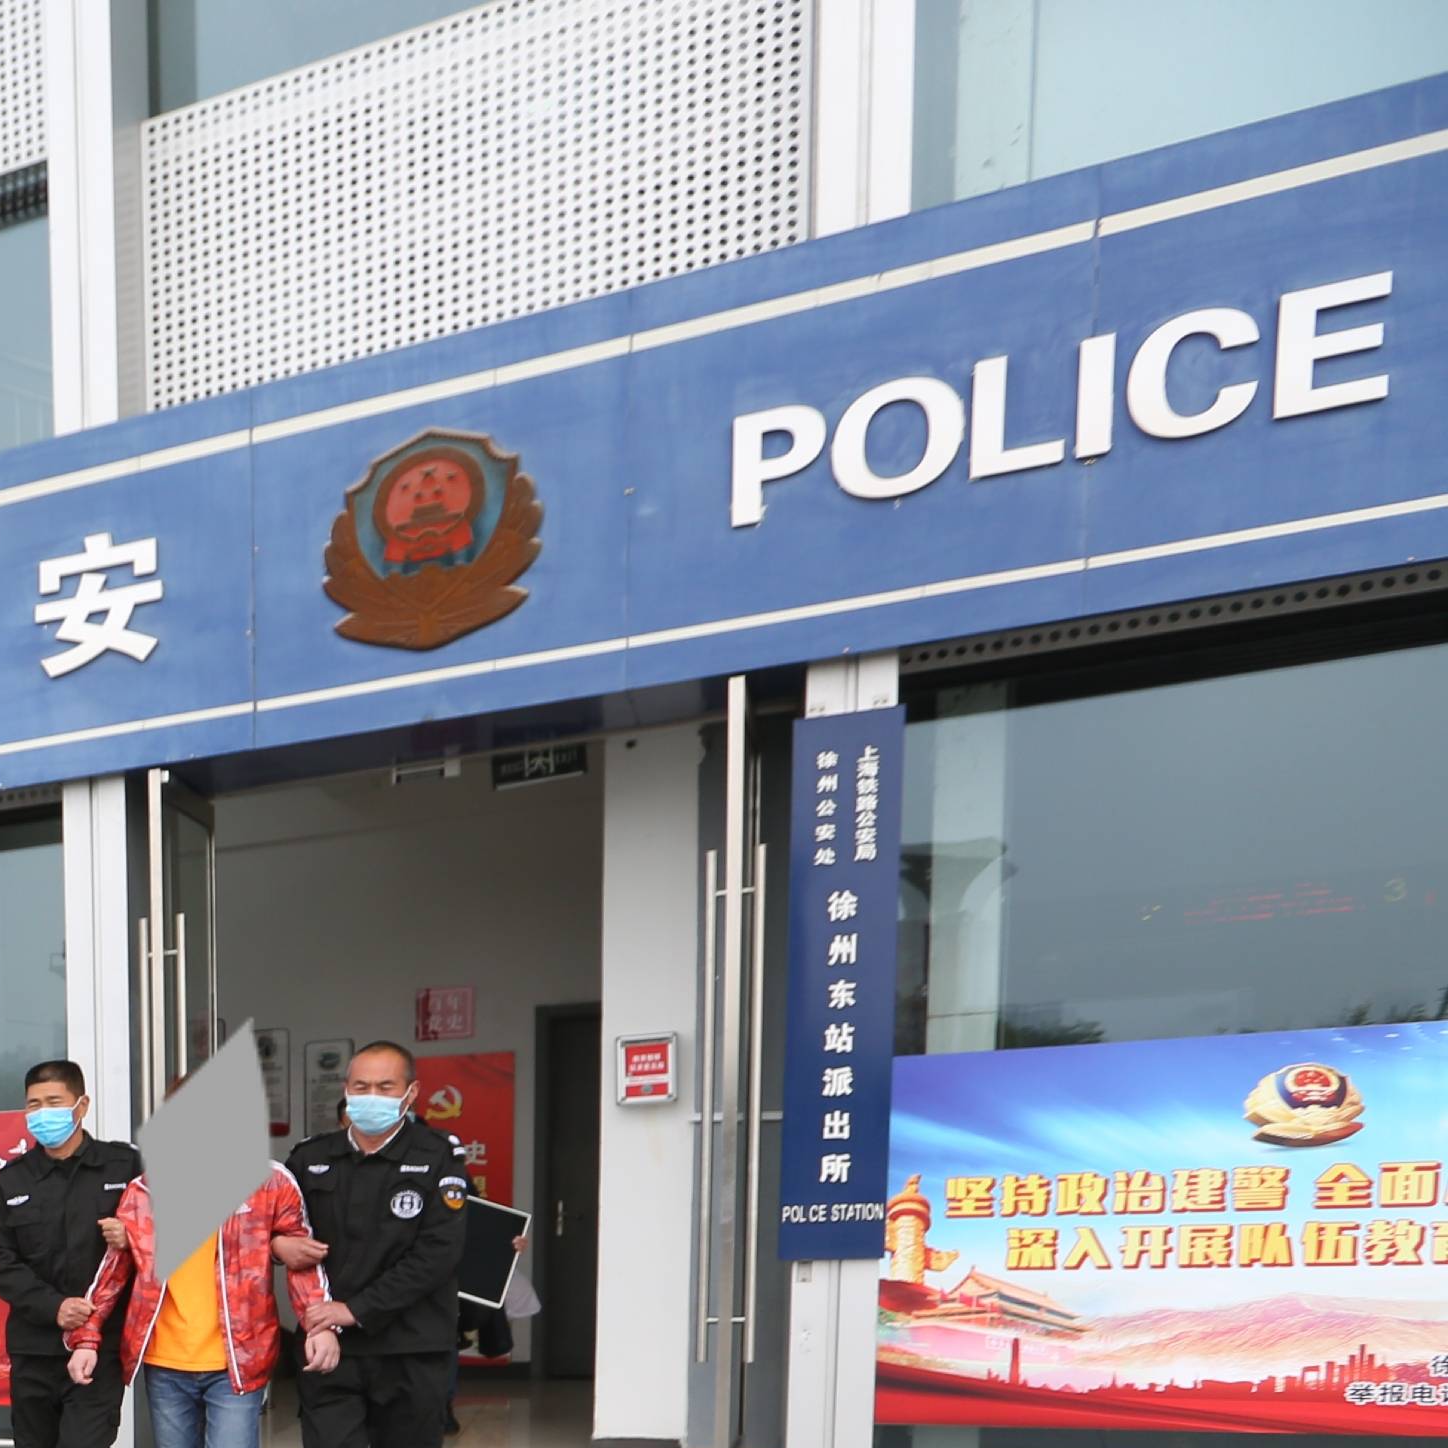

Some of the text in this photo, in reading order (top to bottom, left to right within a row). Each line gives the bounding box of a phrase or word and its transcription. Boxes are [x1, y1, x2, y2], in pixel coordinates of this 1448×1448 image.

[731, 270, 1394, 528] POLICE
[812, 750, 840, 867] 徐州公安处
[819, 889, 859, 1184] 徐州东站派出所
[831, 1203, 884, 1222] STATION
[945, 1162, 1448, 1218] 坚持政治建警 全面
